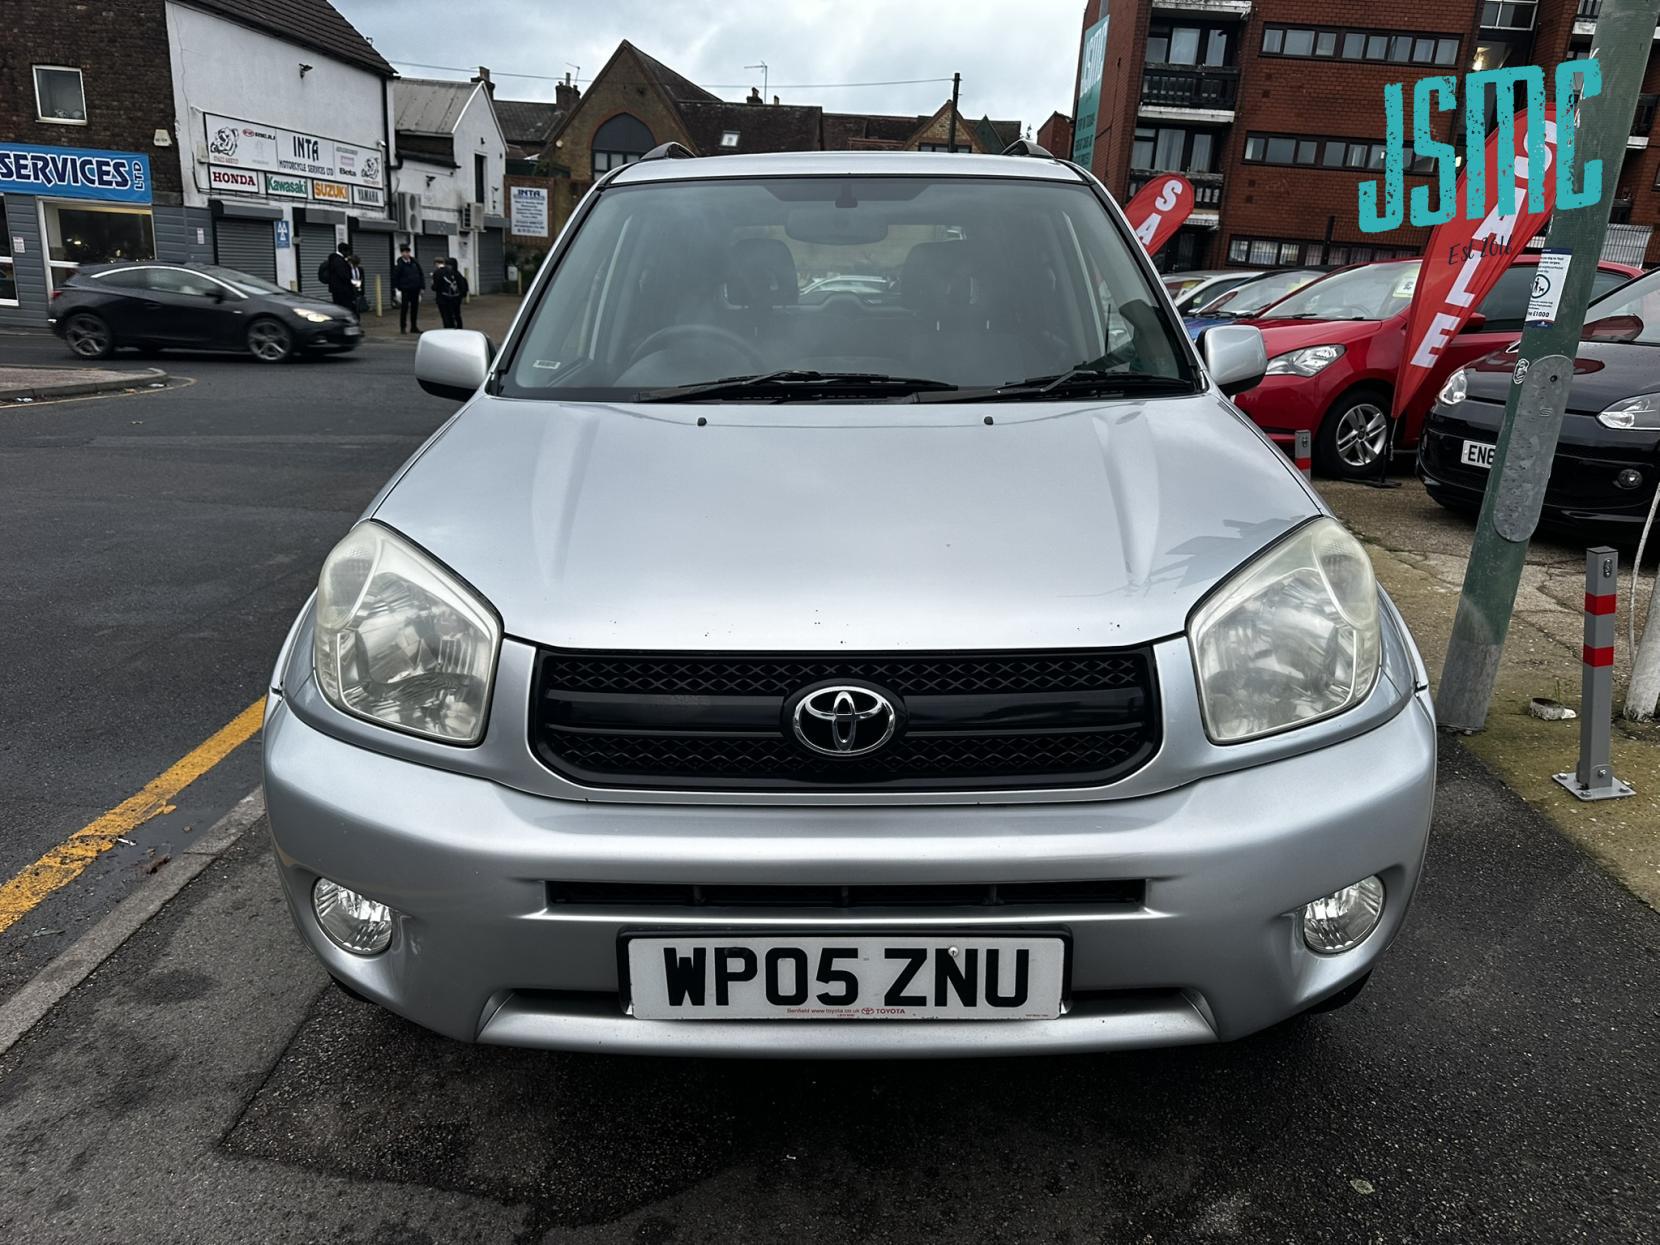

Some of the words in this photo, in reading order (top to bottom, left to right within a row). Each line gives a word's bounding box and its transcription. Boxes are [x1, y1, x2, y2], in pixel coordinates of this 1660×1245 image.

[293, 136, 319, 162] INTA
[0, 151, 130, 189] SERVICES
[132, 161, 145, 191] LTD
[212, 171, 256, 186] HONDA
[307, 164, 326, 174] SERVICES
[267, 175, 307, 194] Kawasaki
[315, 182, 349, 199] SUZUKI
[357, 188, 380, 203] YAMAHA
[884, 948, 1029, 1008] ZNU
